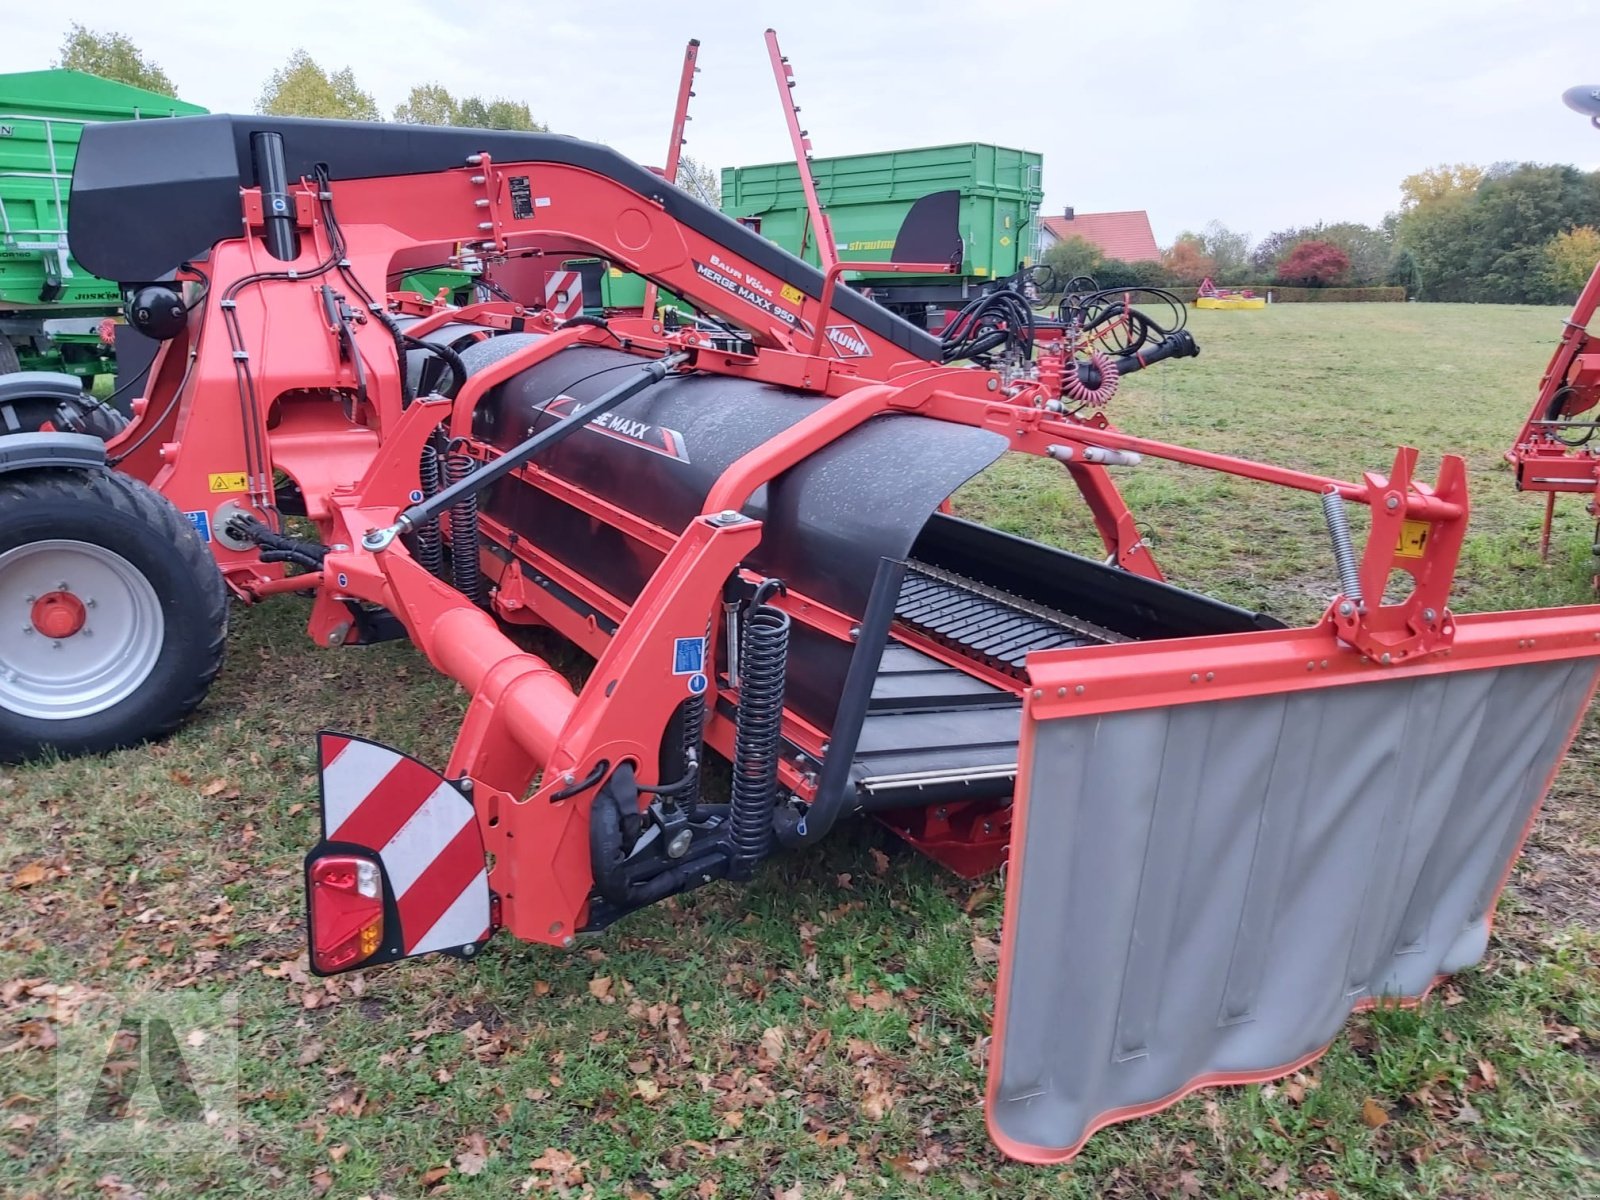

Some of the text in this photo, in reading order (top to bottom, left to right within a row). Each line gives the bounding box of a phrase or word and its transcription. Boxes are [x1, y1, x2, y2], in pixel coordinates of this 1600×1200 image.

[849, 240, 896, 251] strautma
[698, 264, 795, 323] MERGE MAXX 950
[829, 328, 866, 355] KUHN
[608, 415, 652, 440] MAXX
